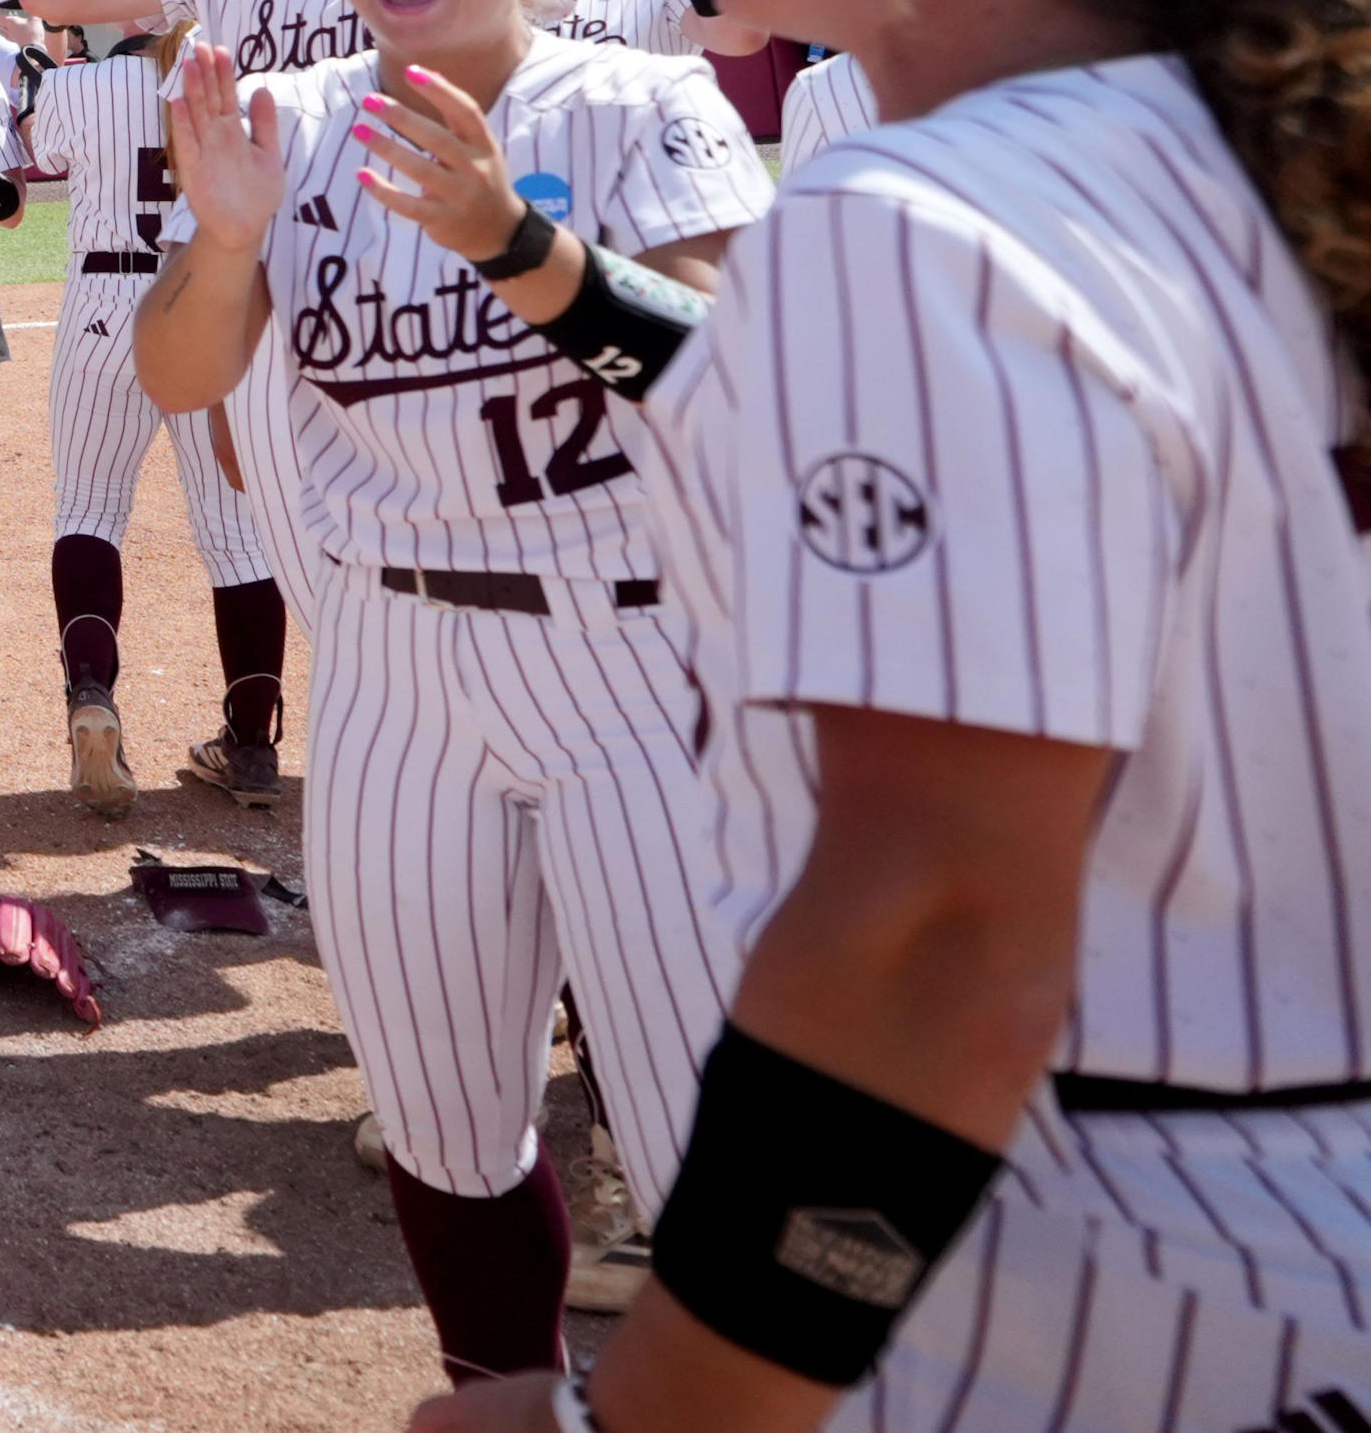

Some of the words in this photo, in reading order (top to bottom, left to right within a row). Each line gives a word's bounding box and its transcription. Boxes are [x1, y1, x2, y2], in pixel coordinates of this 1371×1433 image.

[662, 122, 730, 166] SEC
[293, 255, 537, 370] State
[581, 345, 643, 384] 12
[479, 378, 637, 508] 12
[803, 469, 926, 556] SEC
[168, 872, 218, 888] MISSISSIPPI
[218, 872, 239, 888] STATE
